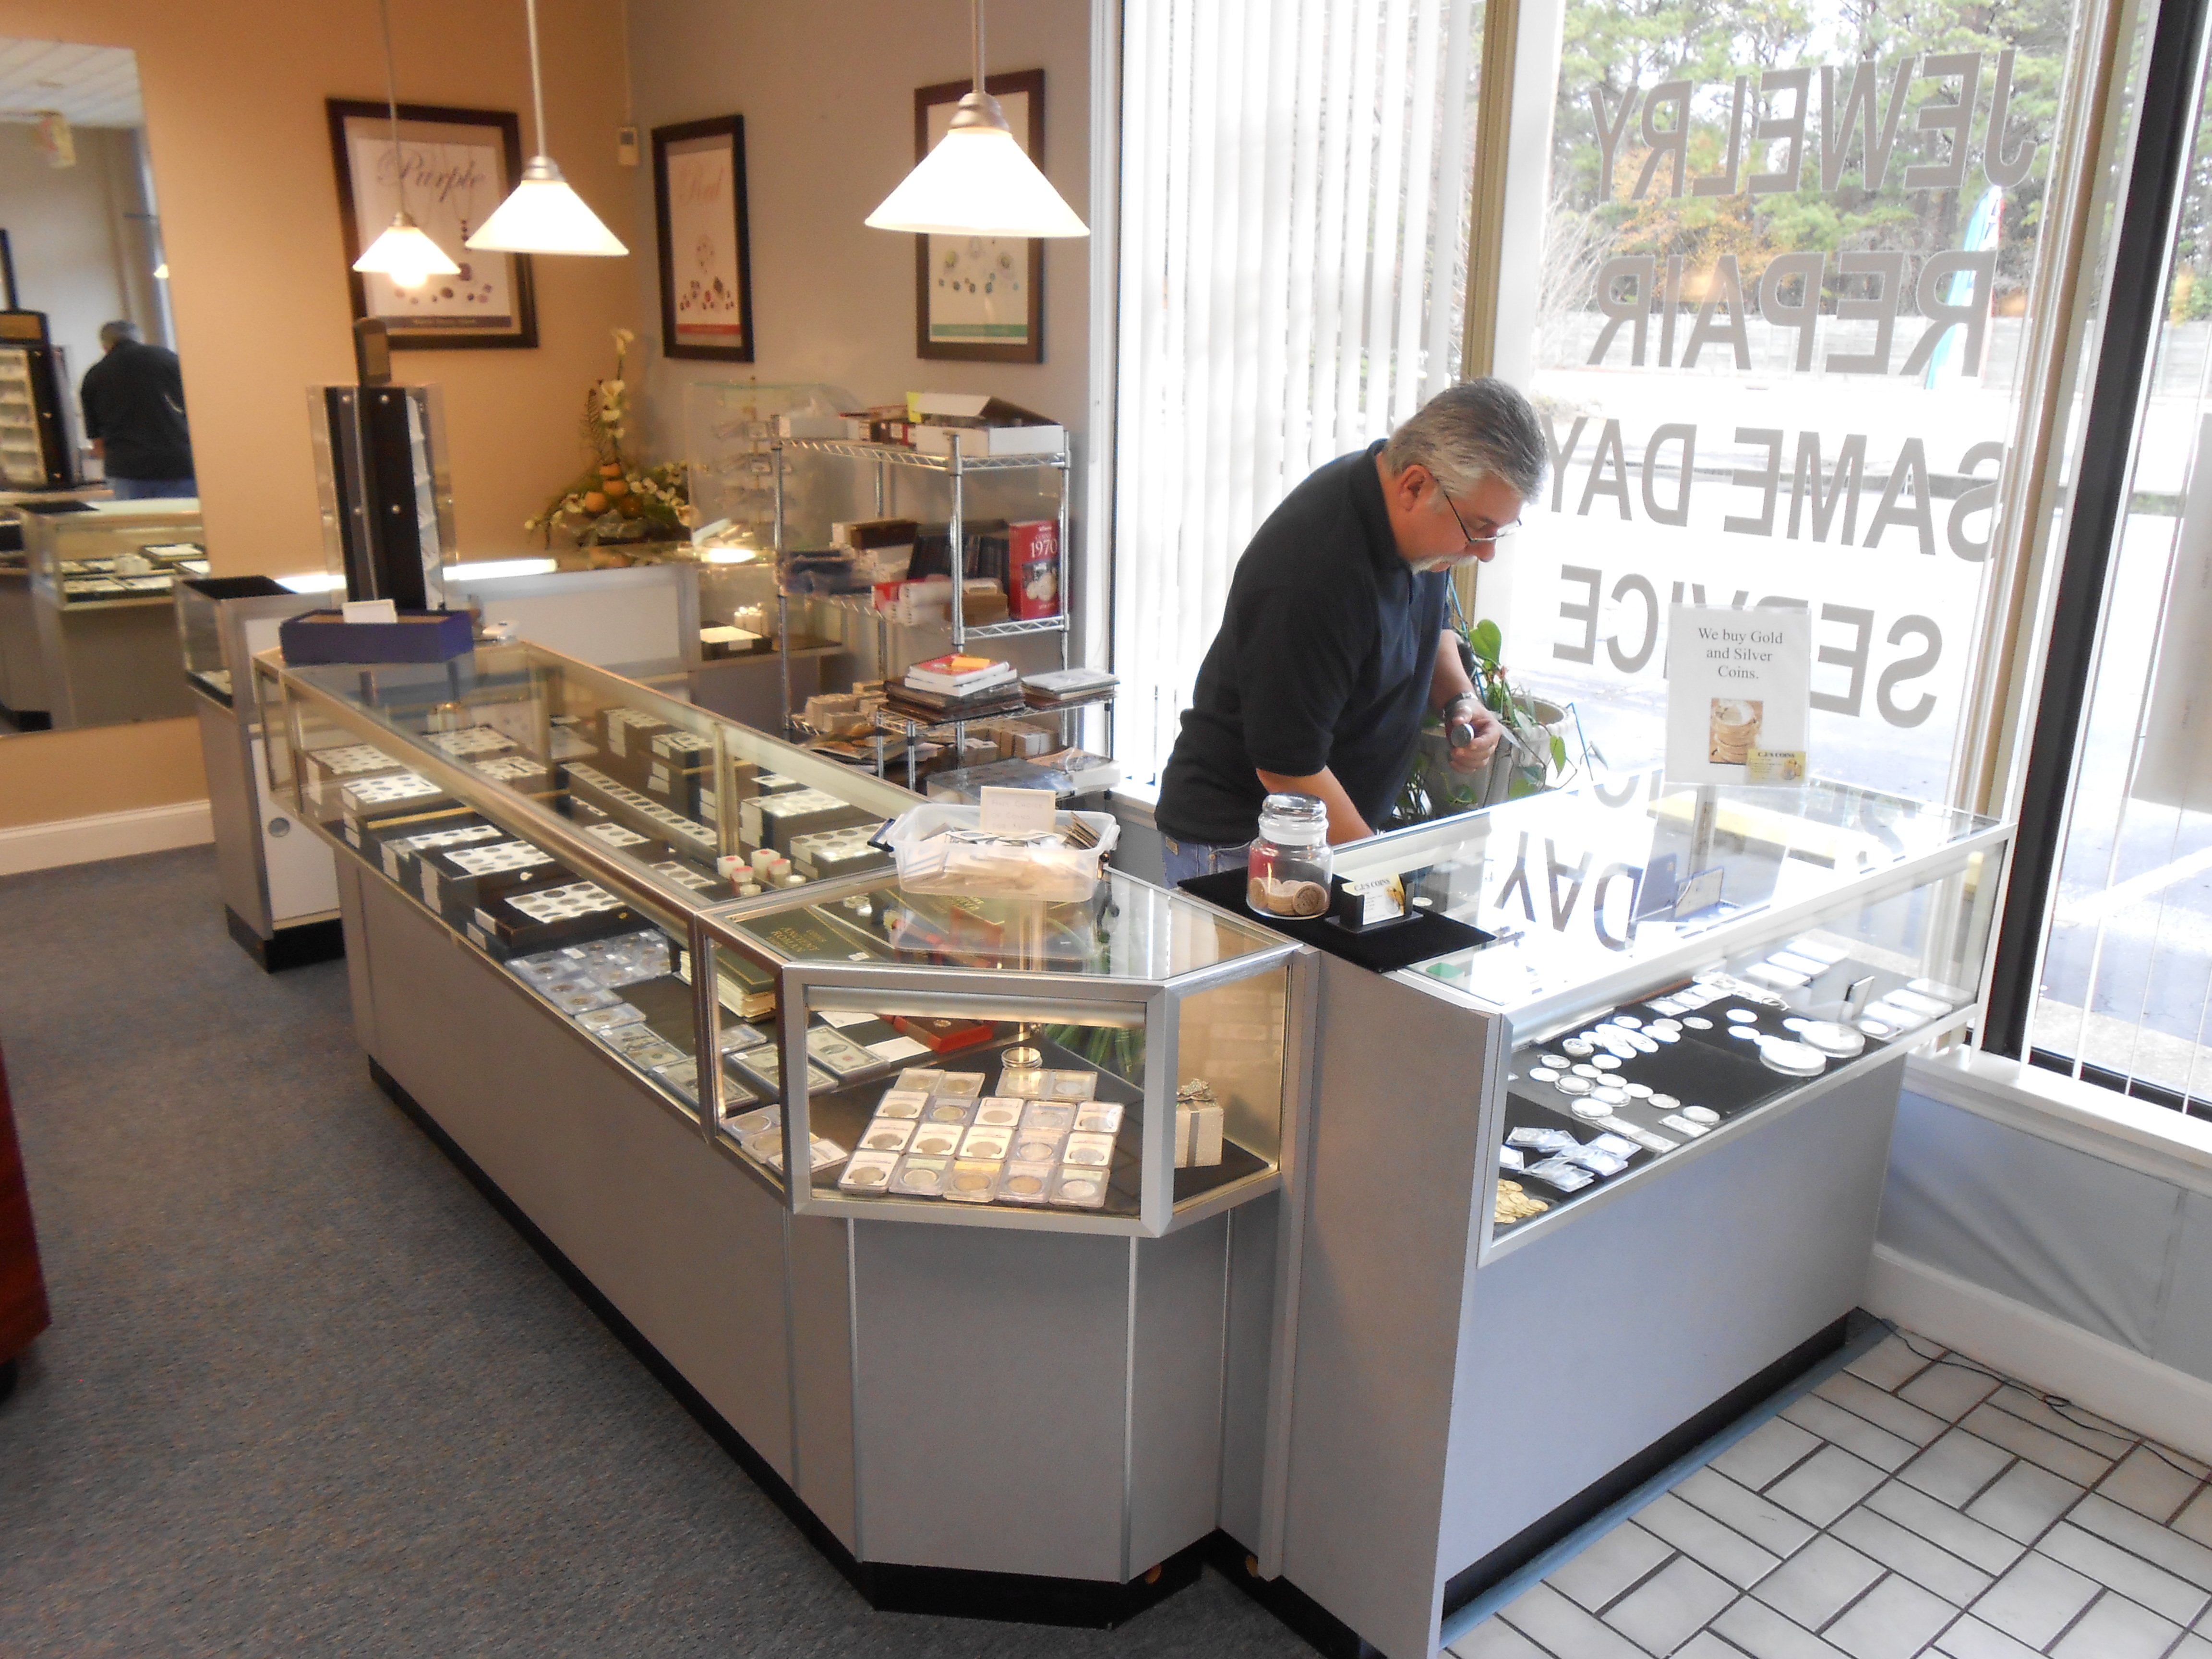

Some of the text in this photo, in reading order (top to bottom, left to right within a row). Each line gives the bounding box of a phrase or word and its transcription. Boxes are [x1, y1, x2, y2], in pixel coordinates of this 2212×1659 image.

[377, 147, 486, 202] Purple
[1030, 538, 1058, 558] 1970
[1698, 627, 1783, 645] We buy Gold
[1706, 647, 1773, 661] and Silver
[1718, 665, 1759, 679] Coins.
[1370, 878, 1391, 888] COINS
